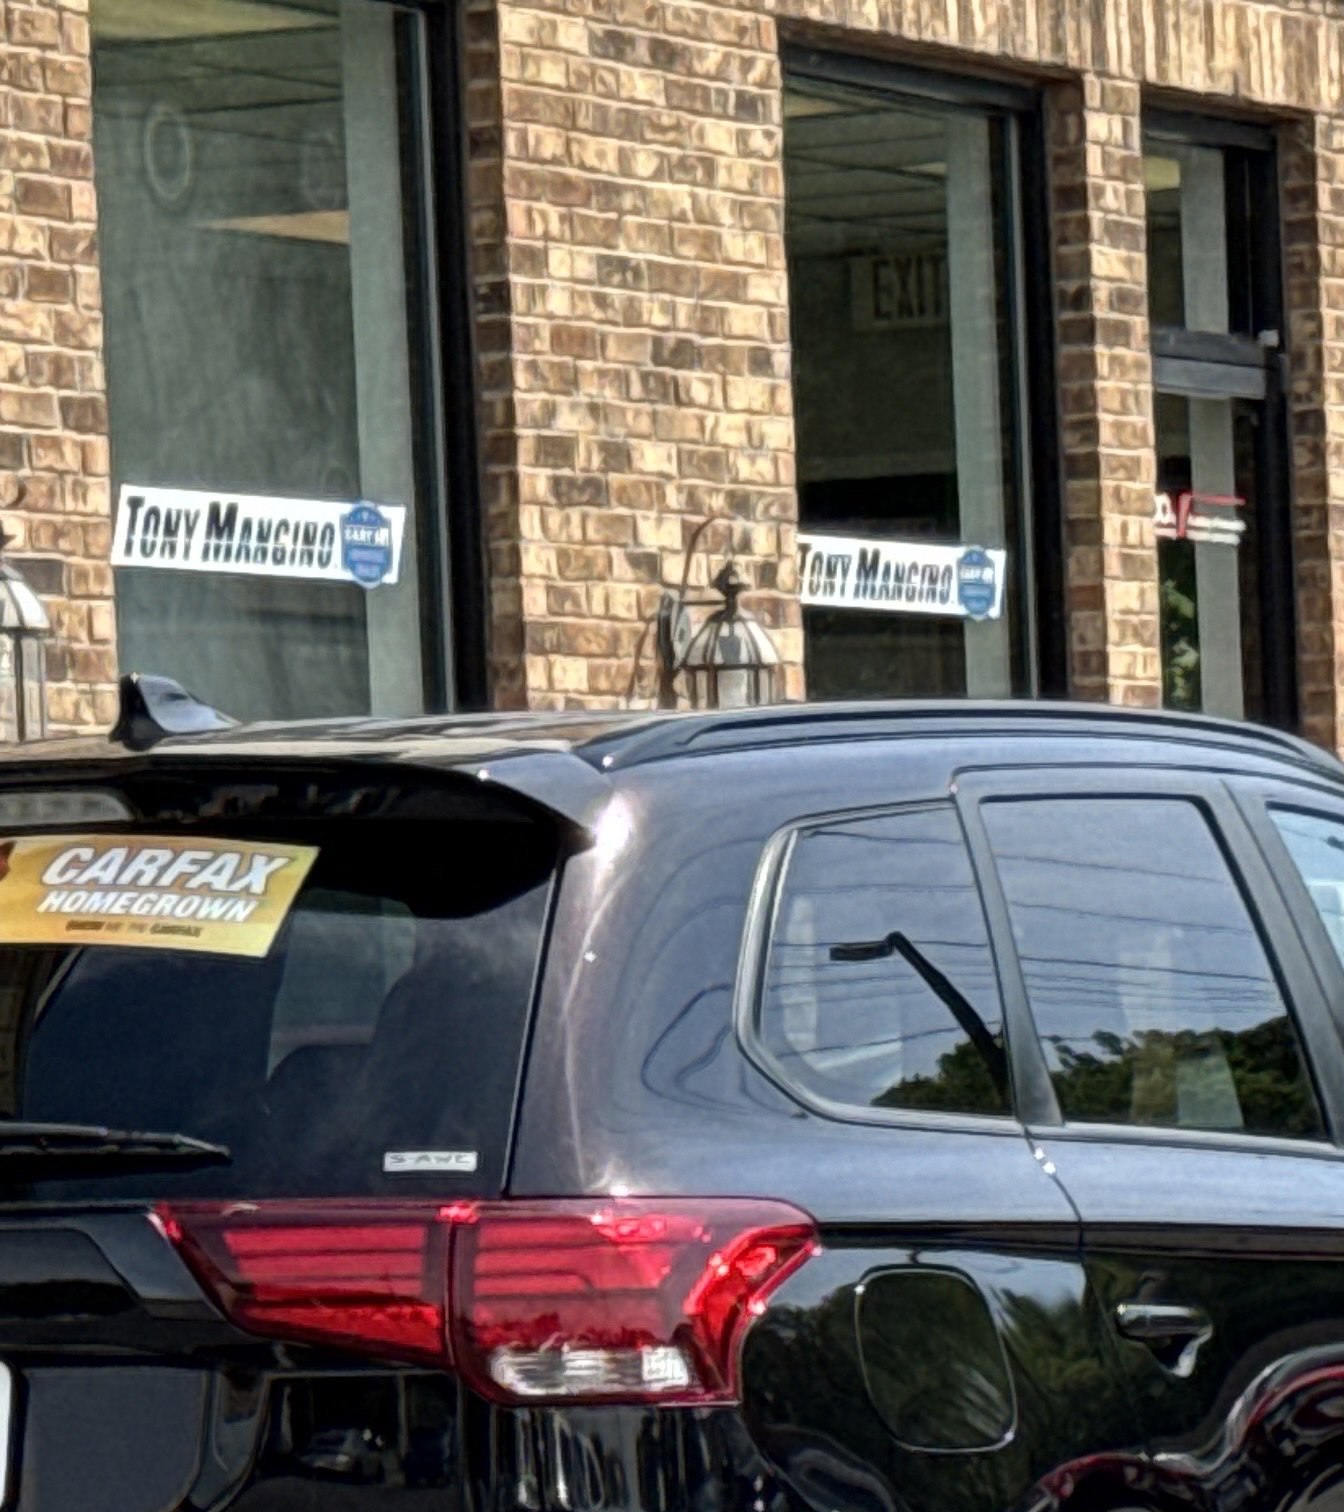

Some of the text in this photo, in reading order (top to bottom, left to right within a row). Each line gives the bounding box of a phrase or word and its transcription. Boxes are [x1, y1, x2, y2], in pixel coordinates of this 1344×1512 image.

[123, 495, 201, 562] TONY
[41, 846, 292, 895] CARFAX
[36, 889, 259, 923] HOMEGROWN
